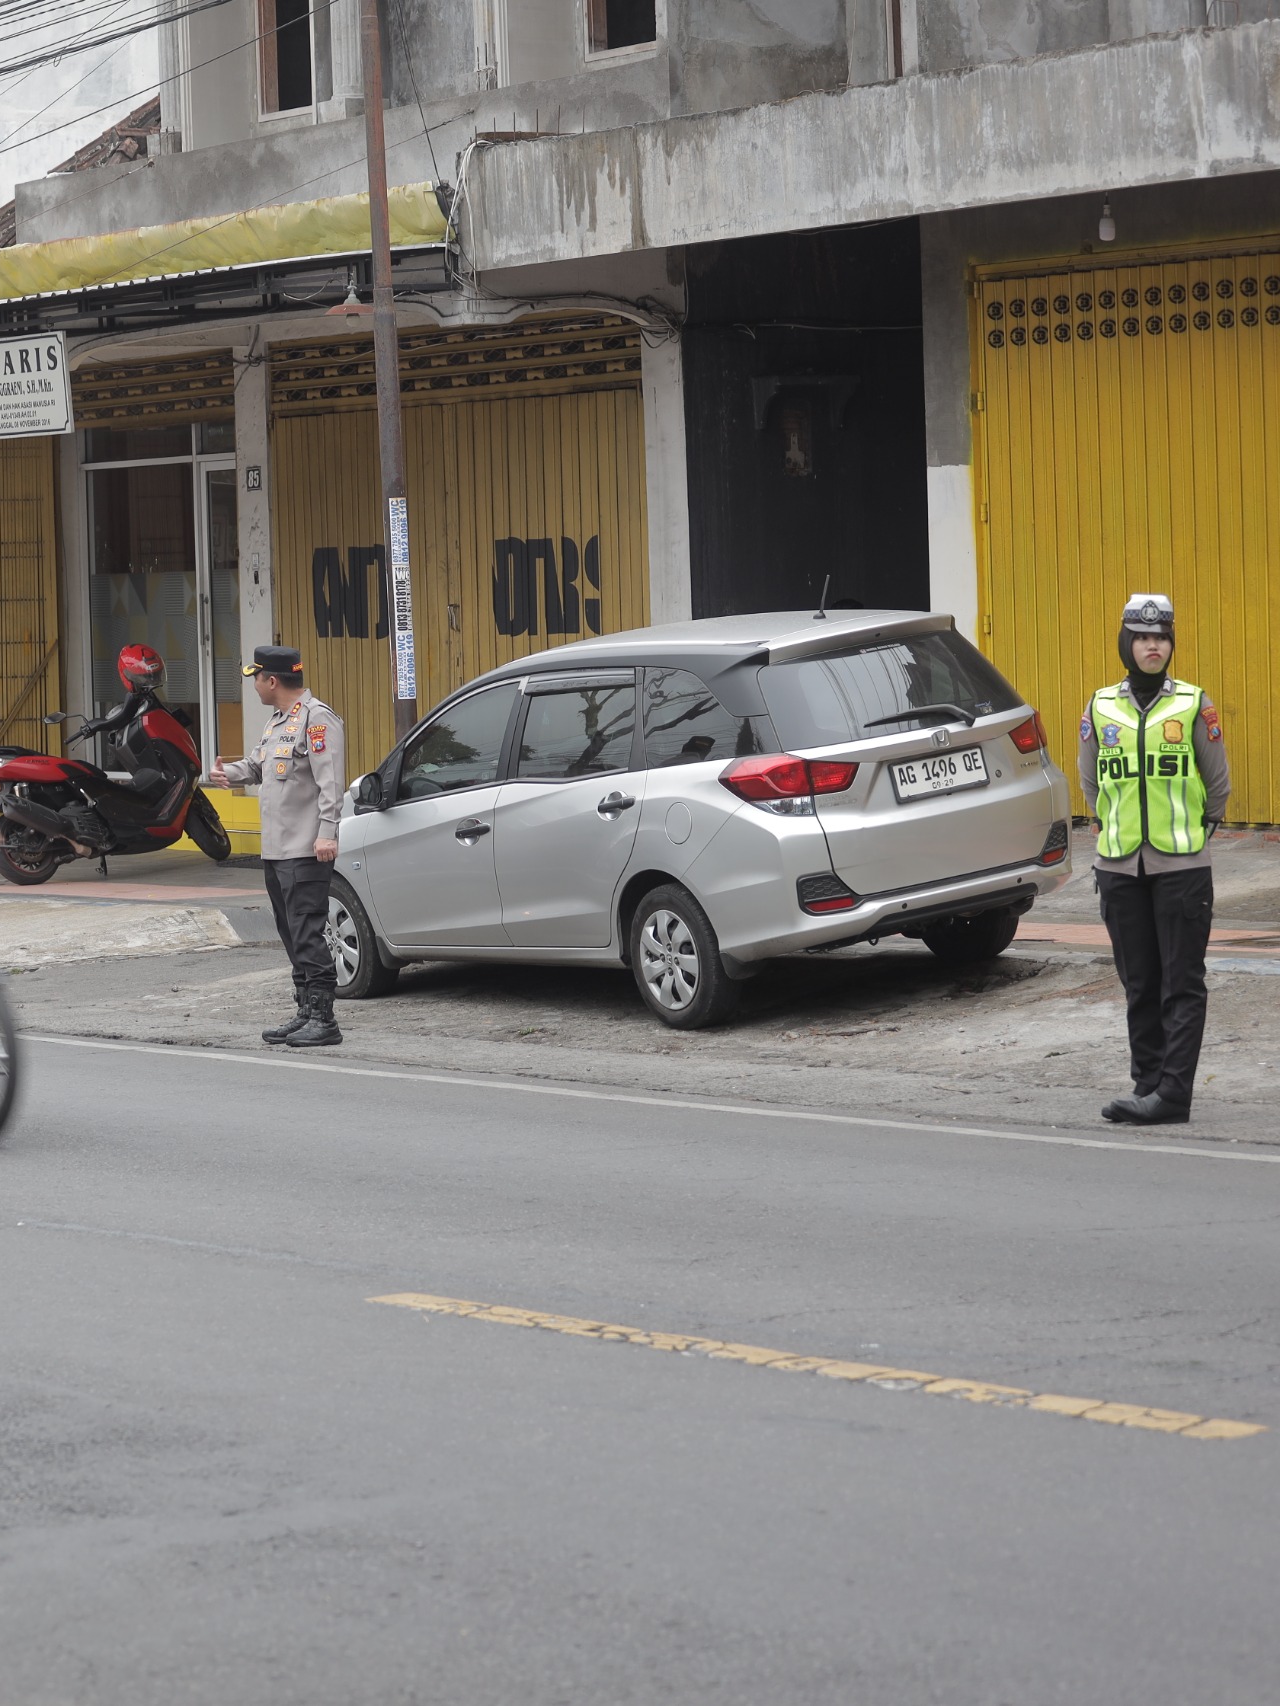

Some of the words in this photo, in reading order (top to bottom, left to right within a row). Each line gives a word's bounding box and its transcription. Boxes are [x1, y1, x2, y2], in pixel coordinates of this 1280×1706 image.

[248, 470, 259, 487] 85
[391, 500, 399, 516] WC
[397, 614, 408, 631] 0813
[398, 635, 406, 651] WC
[898, 765, 917, 786] AG
[922, 758, 956, 782] 1496
[963, 752, 982, 772] QE
[1099, 754, 1188, 781] POLISI
